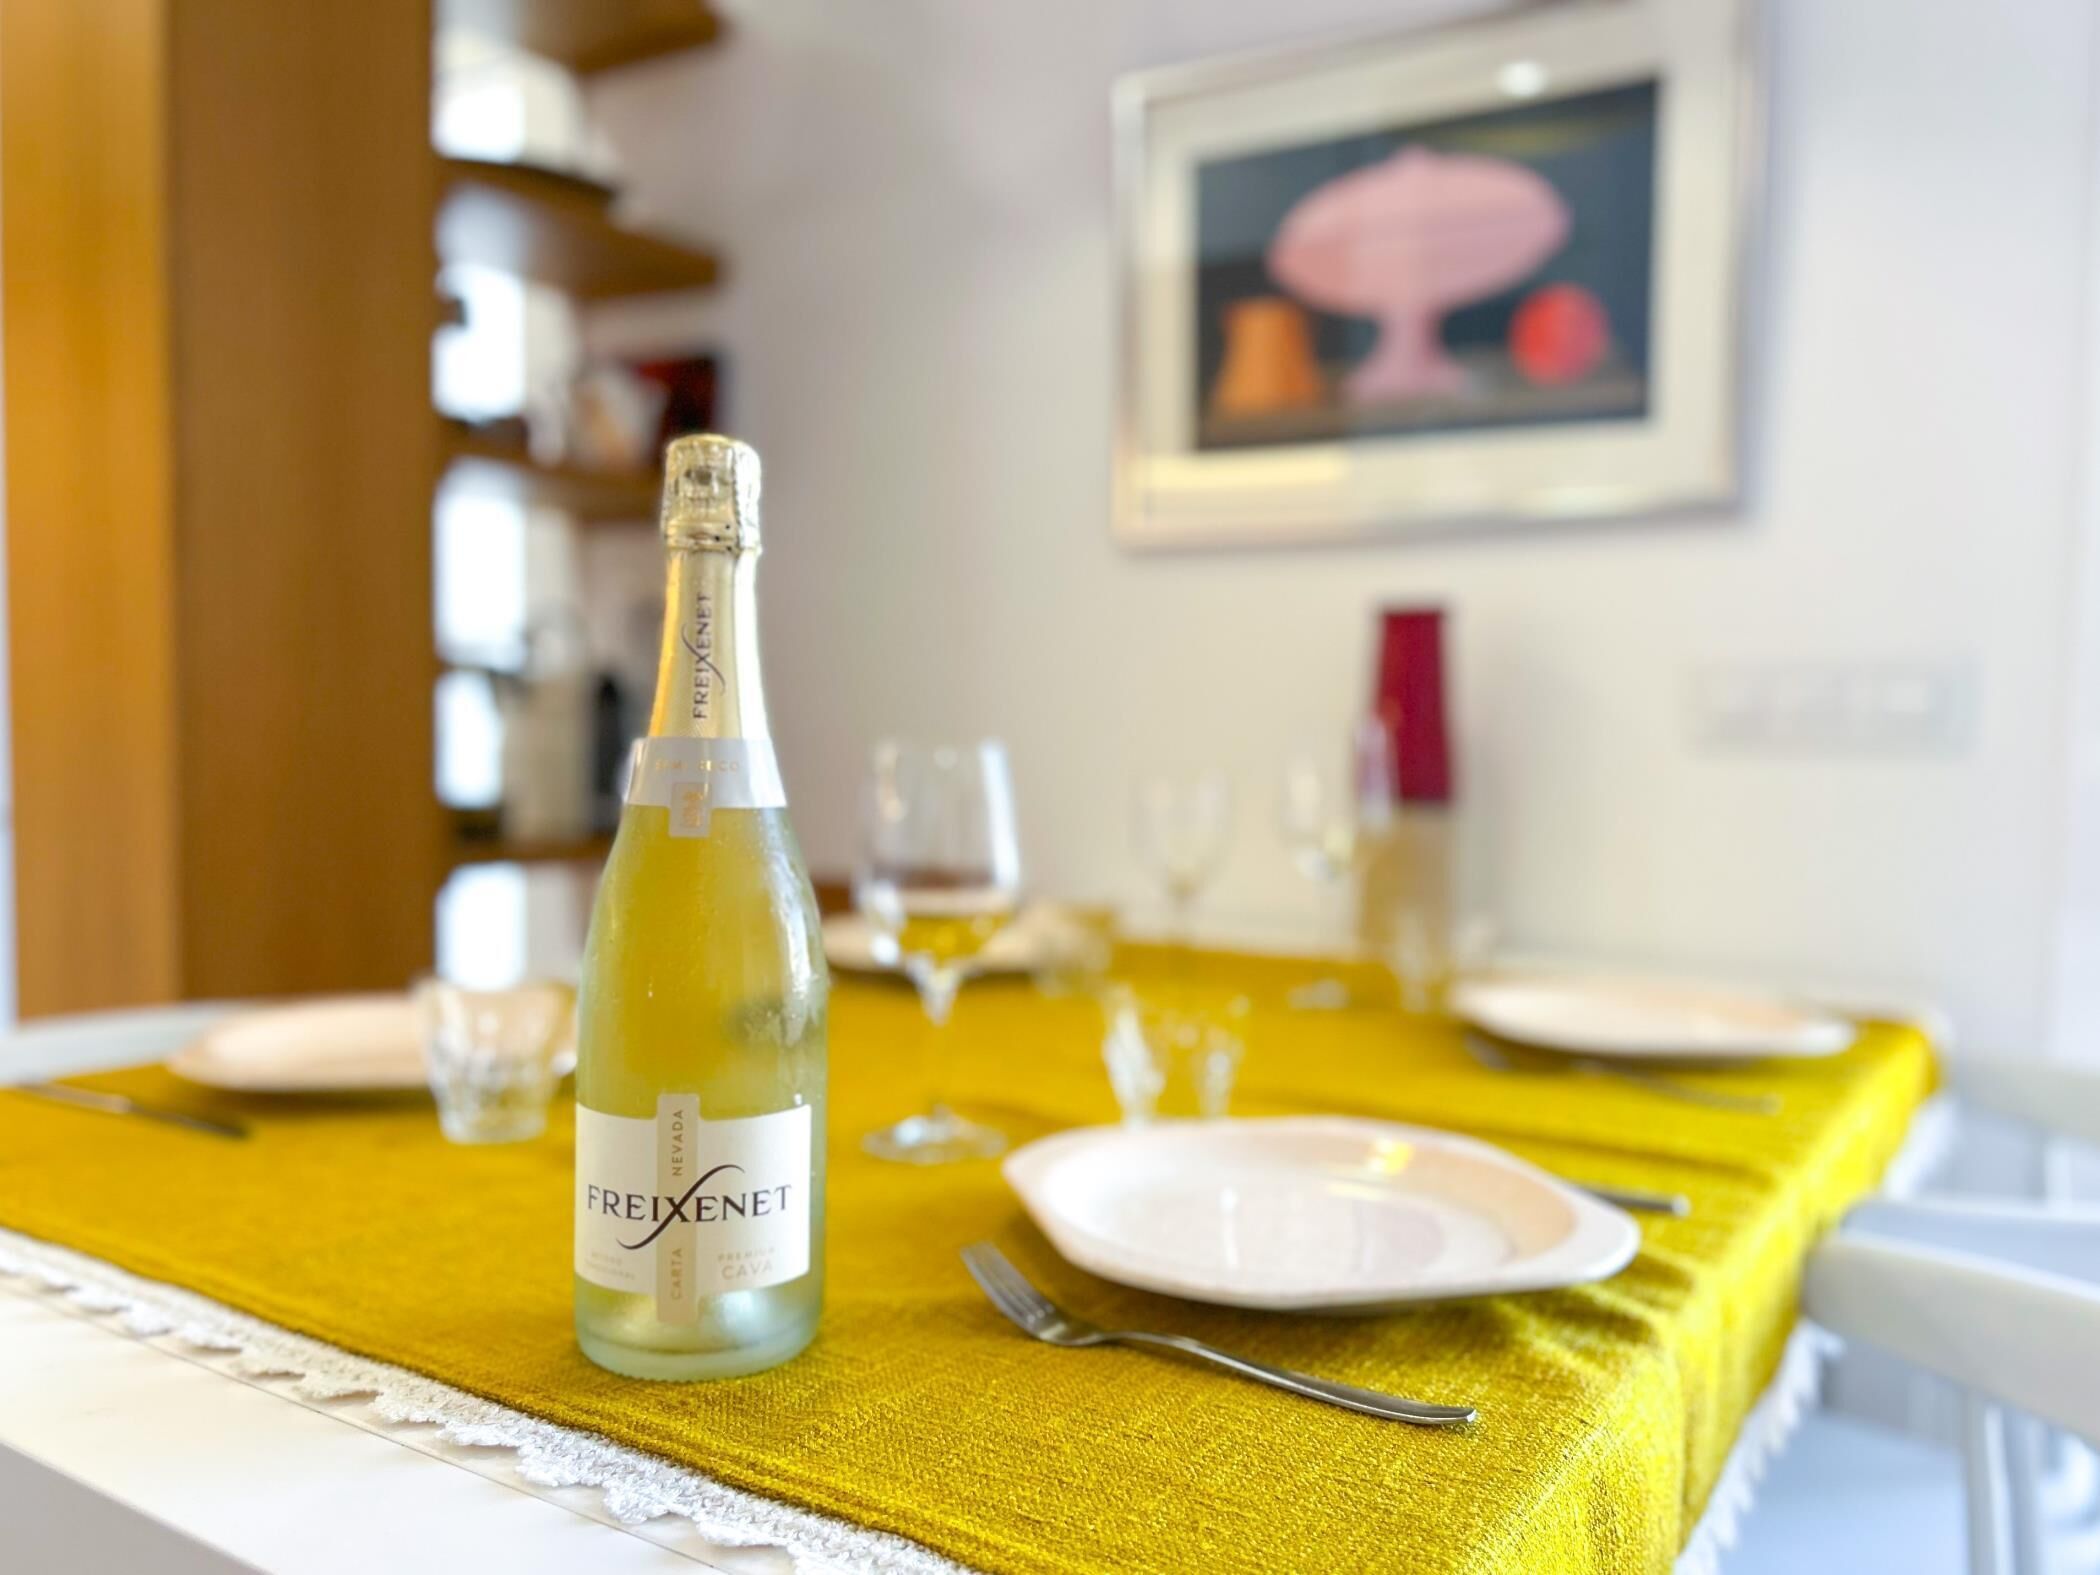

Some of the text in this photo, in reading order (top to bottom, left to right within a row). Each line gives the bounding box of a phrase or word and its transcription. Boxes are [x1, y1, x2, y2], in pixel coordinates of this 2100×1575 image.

[671, 1109, 685, 1300] CARTA NEVADA
[721, 1258, 773, 1281] CAVA
